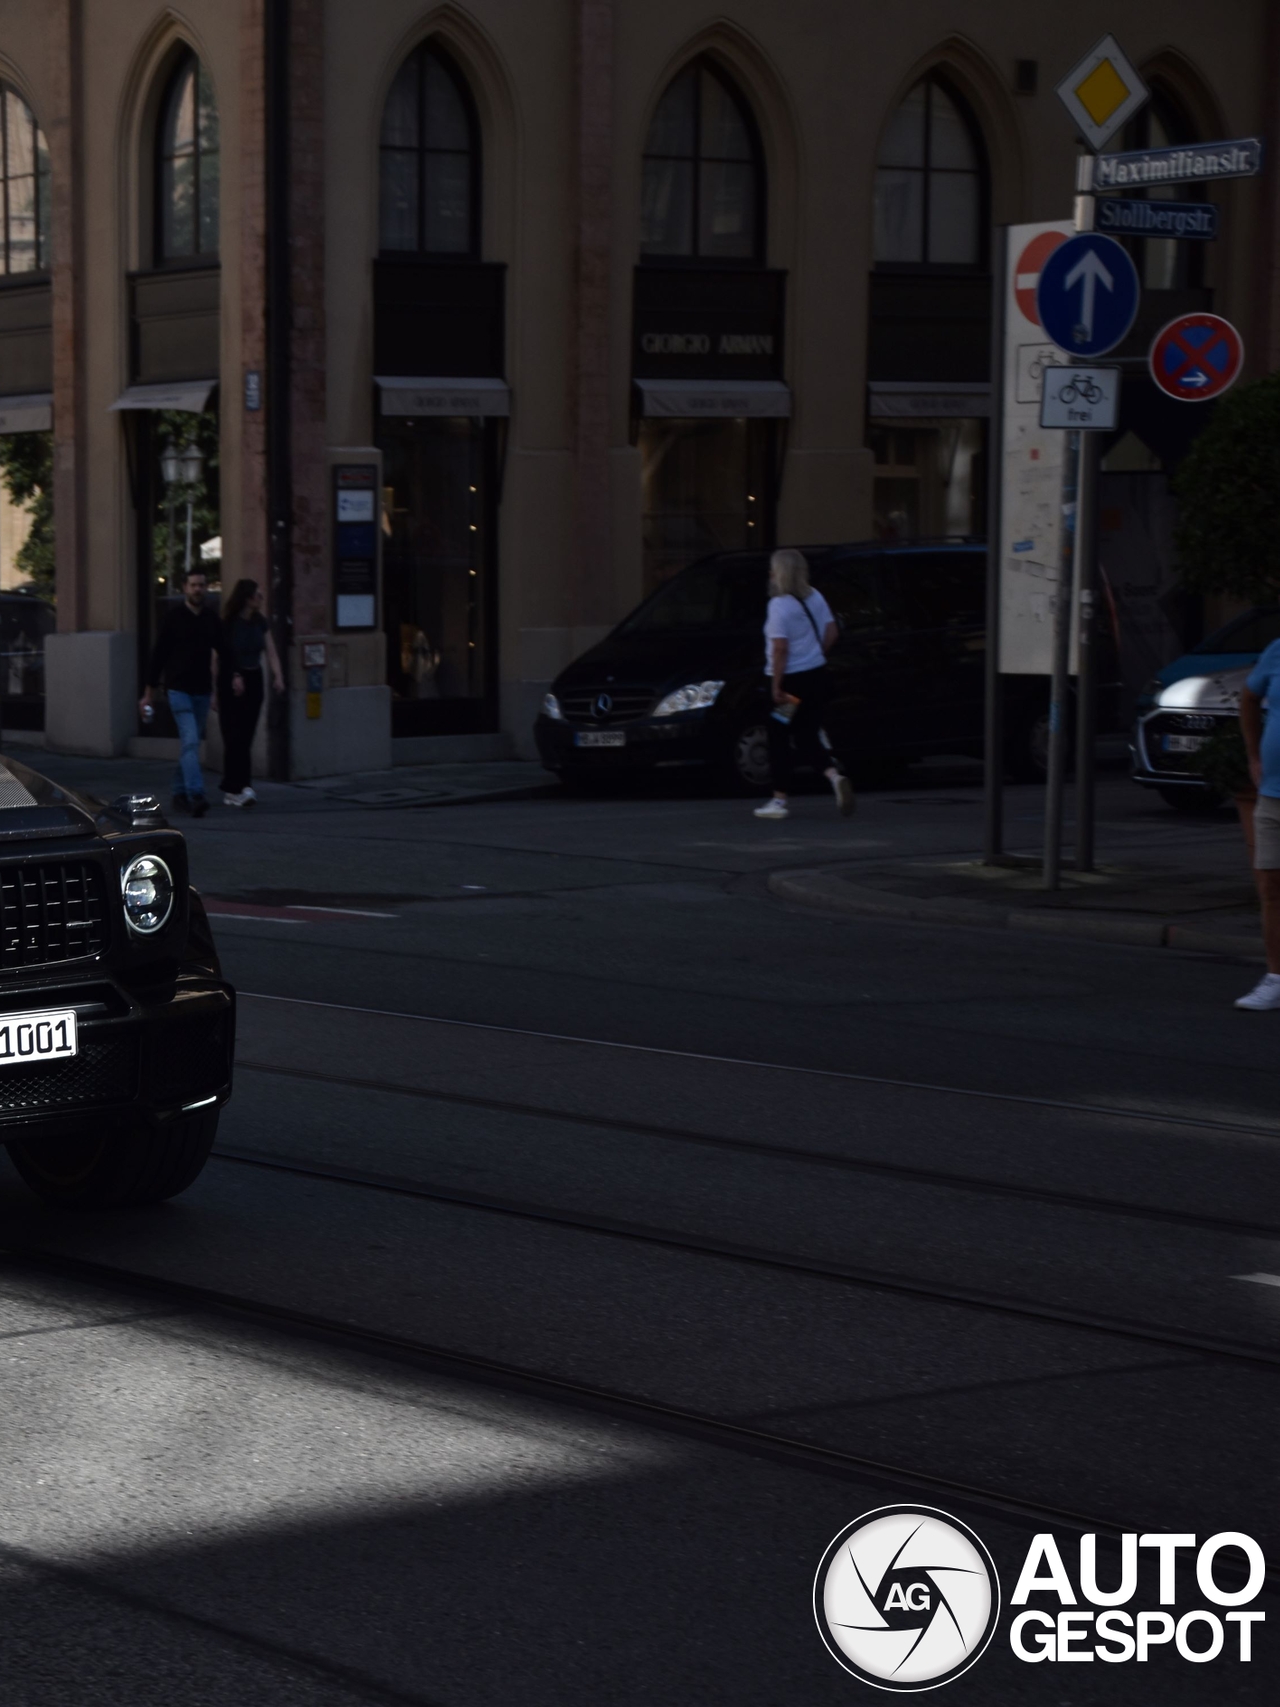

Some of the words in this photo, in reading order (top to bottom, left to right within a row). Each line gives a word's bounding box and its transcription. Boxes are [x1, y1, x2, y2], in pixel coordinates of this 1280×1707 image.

[1099, 149, 1251, 185] Maximilianstr.
[1100, 201, 1213, 235] Stollbergstr.
[1068, 408, 1093, 421] frei
